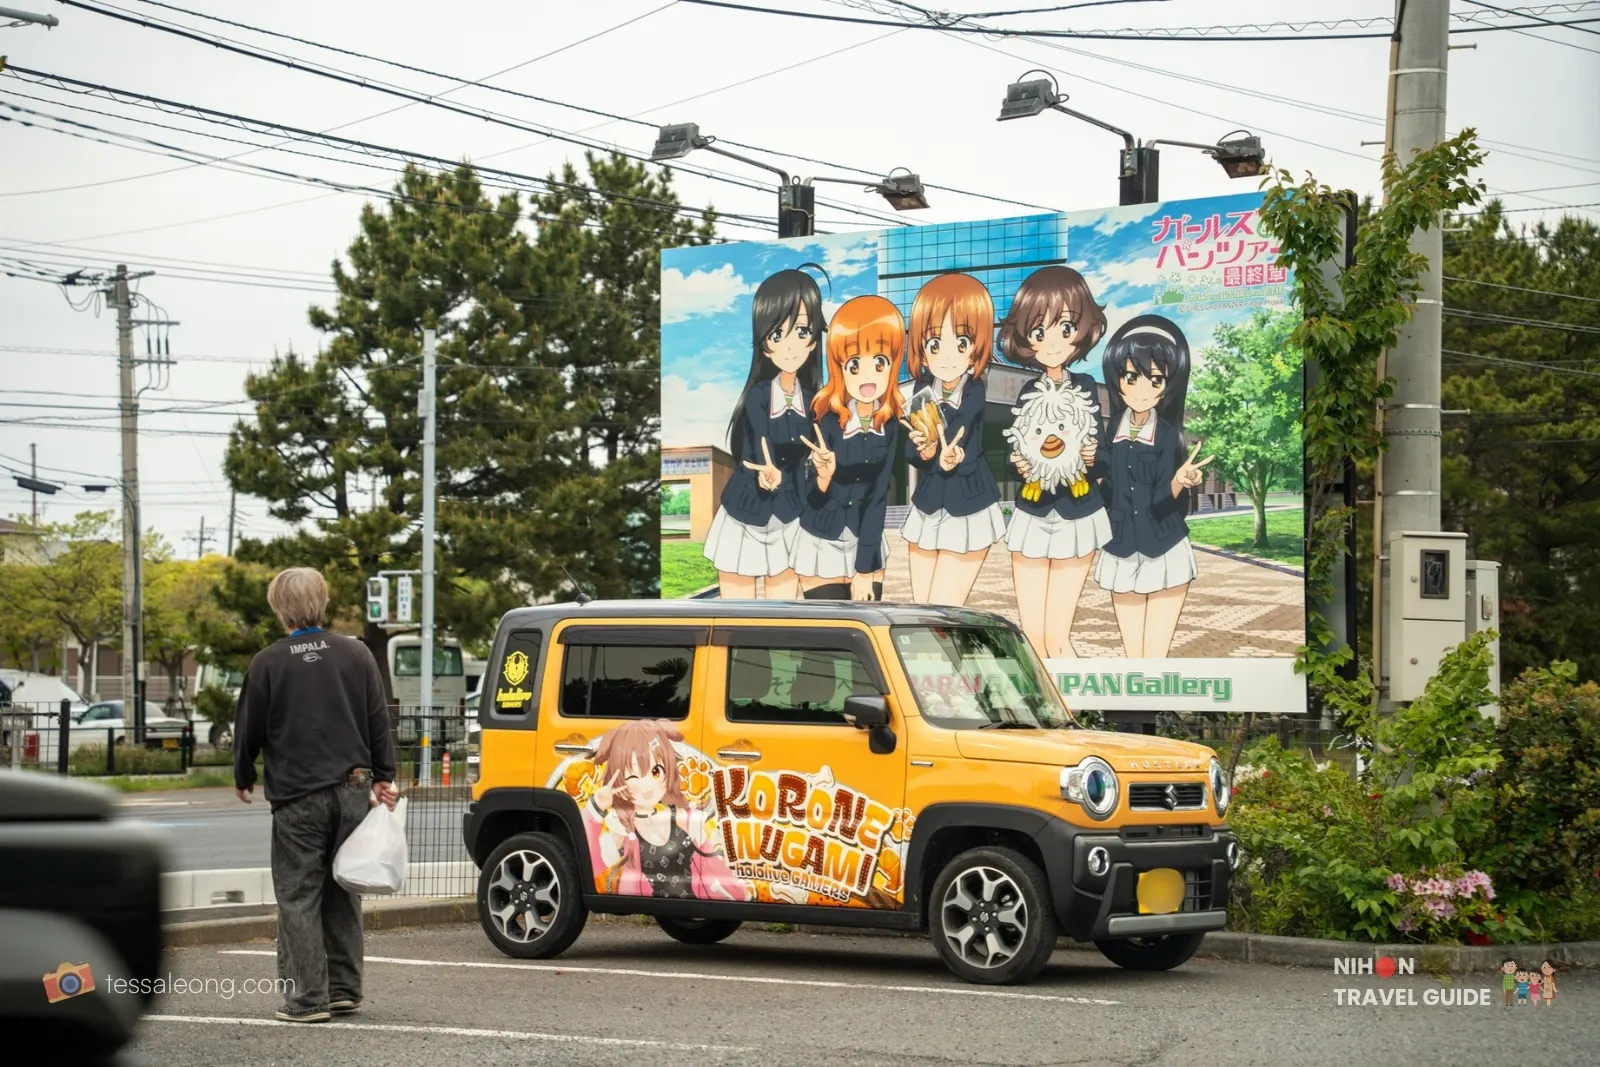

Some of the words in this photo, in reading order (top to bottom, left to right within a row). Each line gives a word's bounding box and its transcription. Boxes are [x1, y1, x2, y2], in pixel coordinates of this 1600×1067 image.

[1223, 263, 1286, 287] 最終章
[1126, 672, 1233, 702] Gallery
[1129, 759, 1201, 770] HUSTLER
[713, 767, 892, 850] KORONE
[721, 819, 874, 892] INUGAMI
[736, 862, 789, 882] hololive
[791, 870, 850, 901] GAMERS
